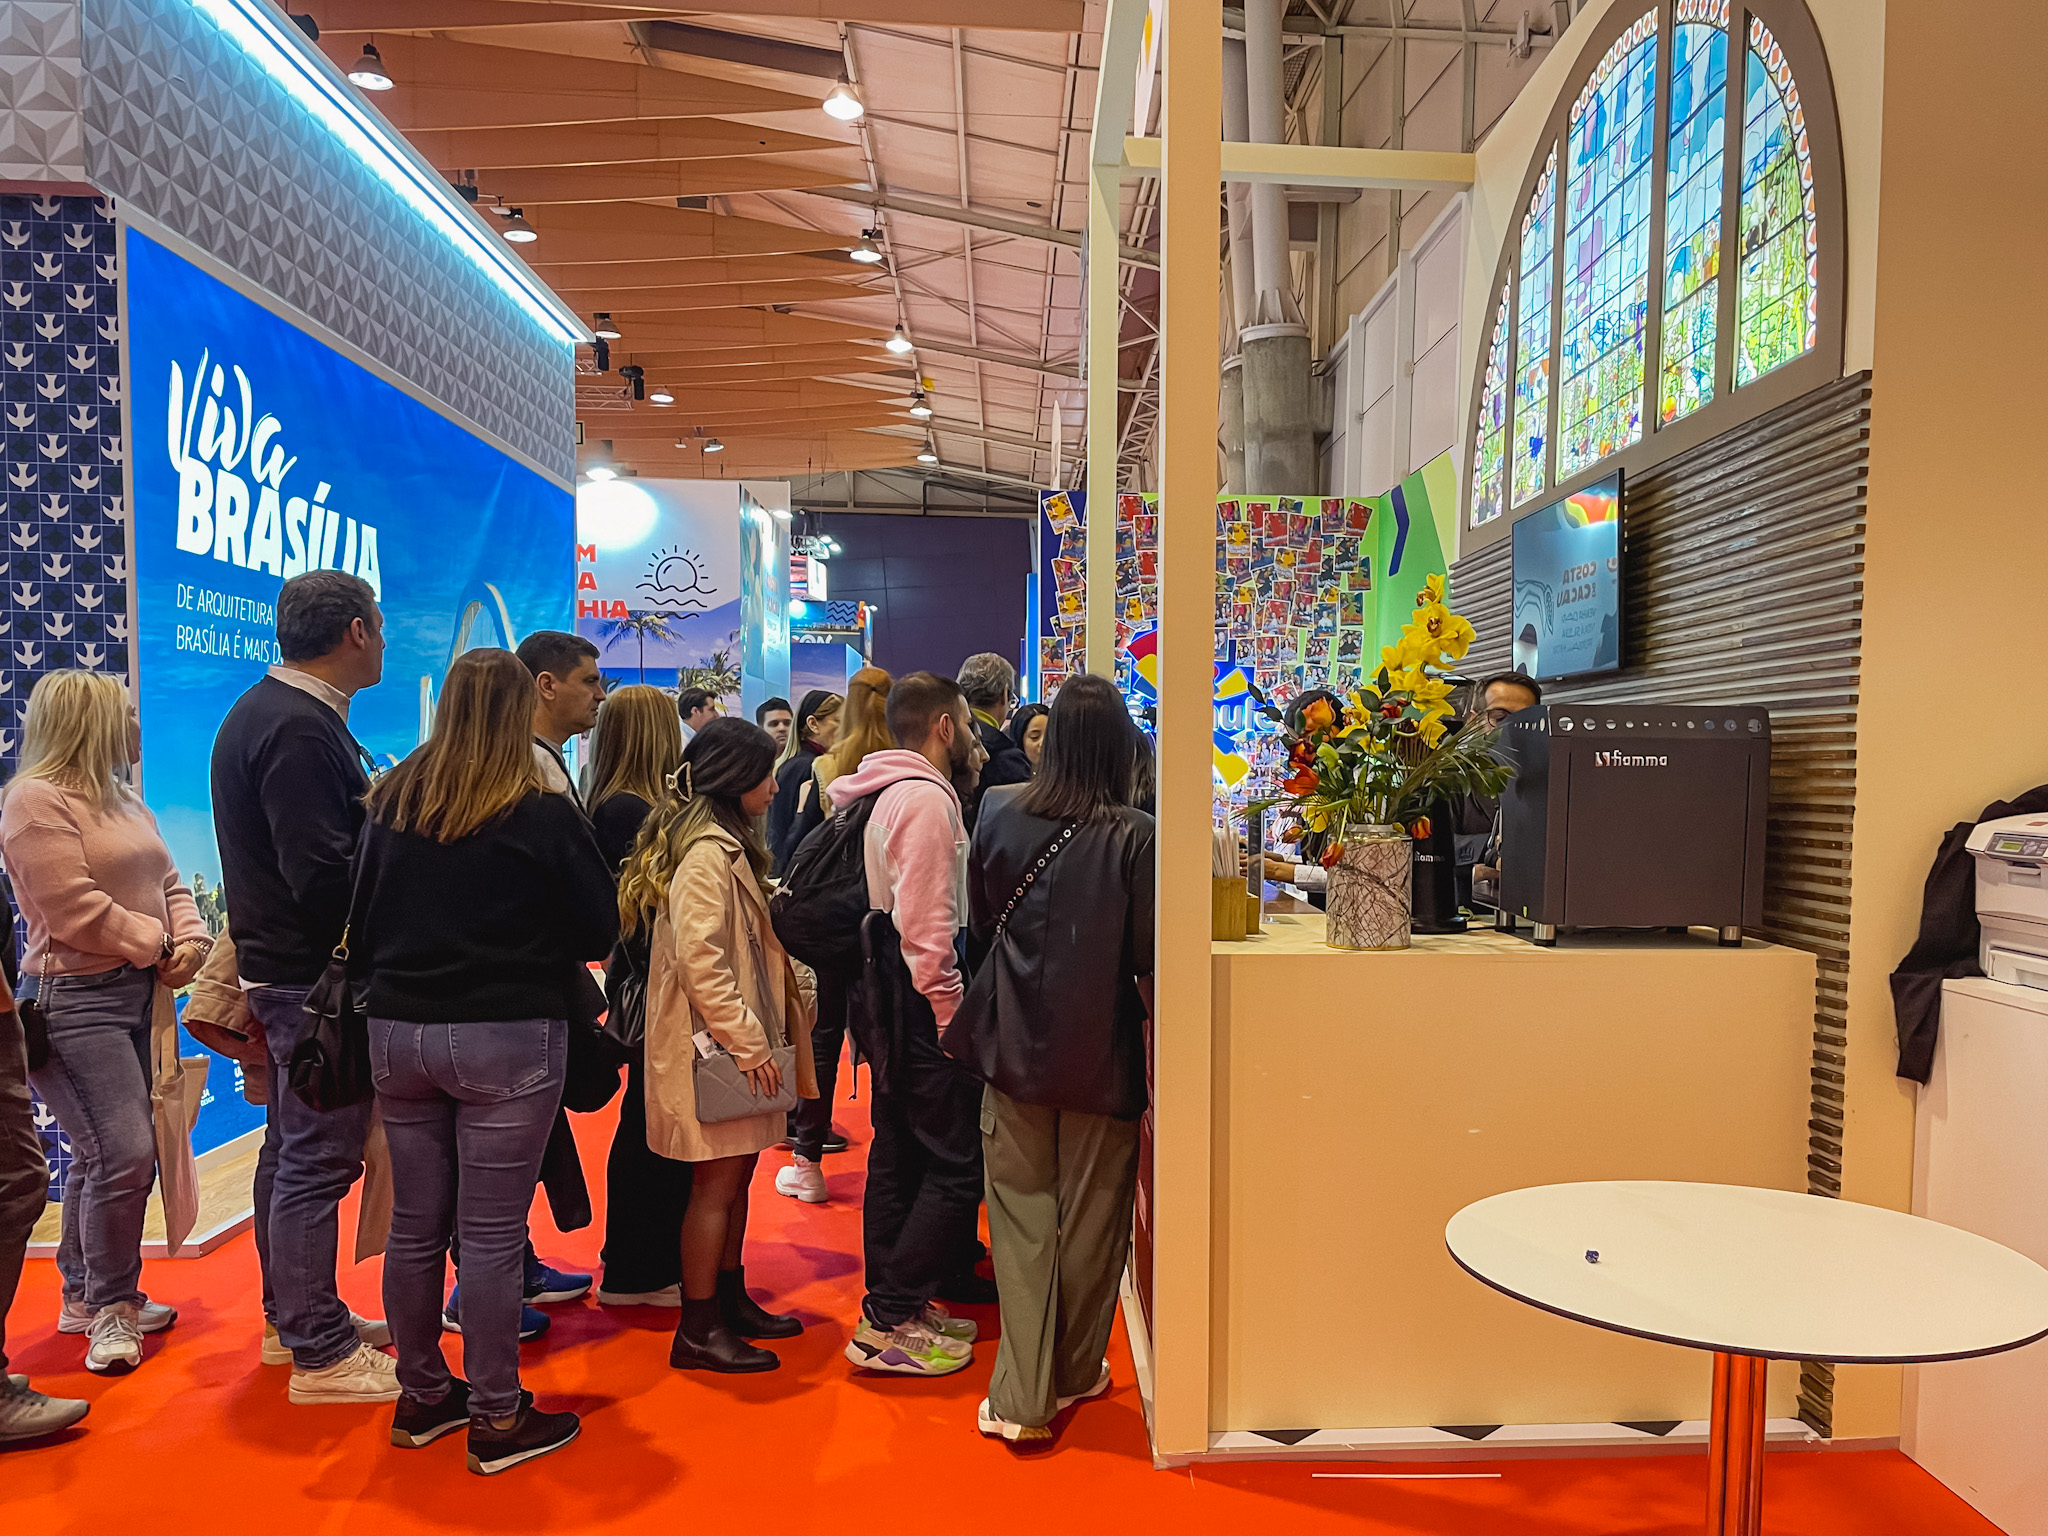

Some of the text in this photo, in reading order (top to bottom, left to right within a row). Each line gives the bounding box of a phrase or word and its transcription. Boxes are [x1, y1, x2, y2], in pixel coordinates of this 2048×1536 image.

[168, 346, 298, 491] Viva
[176, 456, 382, 603] BRASÍLIA
[177, 583, 274, 627] DE ARQUITETURA
[577, 599, 630, 620] HIA
[176, 624, 231, 657] BRASÍLIA
[233, 628, 242, 660] É
[244, 636, 270, 663] MAIS
[1611, 749, 1668, 767] fiamma
